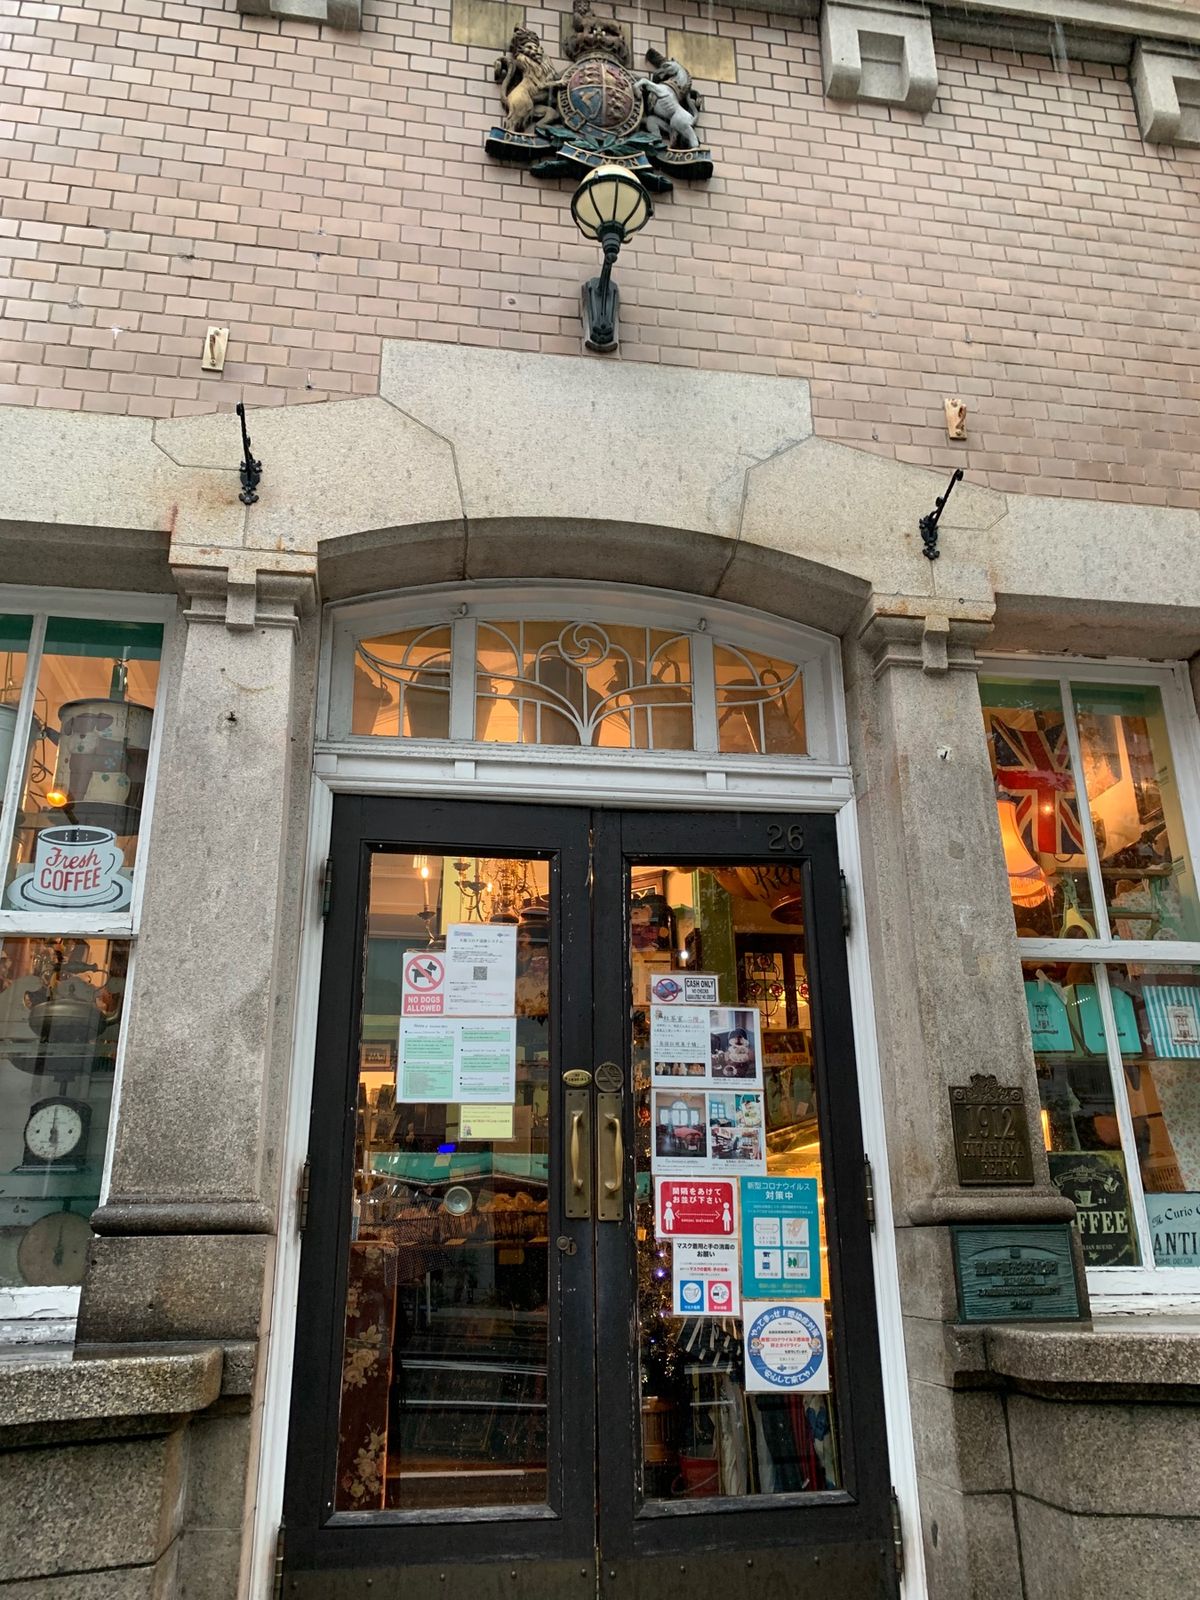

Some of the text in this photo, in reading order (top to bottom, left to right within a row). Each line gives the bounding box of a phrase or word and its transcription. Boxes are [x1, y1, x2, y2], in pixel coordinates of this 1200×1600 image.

[767, 824, 803, 851] 26
[46, 847, 101, 869] Fresh
[40, 867, 102, 892] COFFEE
[686, 980, 713, 988] CASH ONLY
[407, 1004, 441, 1012] ALLOWED
[966, 1106, 1015, 1139] 1912
[672, 1187, 722, 1196] 間隔をあけて
[747, 1182, 810, 1191] 新型コロナウイルス
[672, 1196, 722, 1205] お並び下さい
[765, 1191, 794, 1200] 対策中
[1164, 1207, 1193, 1221] Curio
[1072, 1210, 1128, 1234] FFEE
[1153, 1232, 1198, 1256] ANTI
